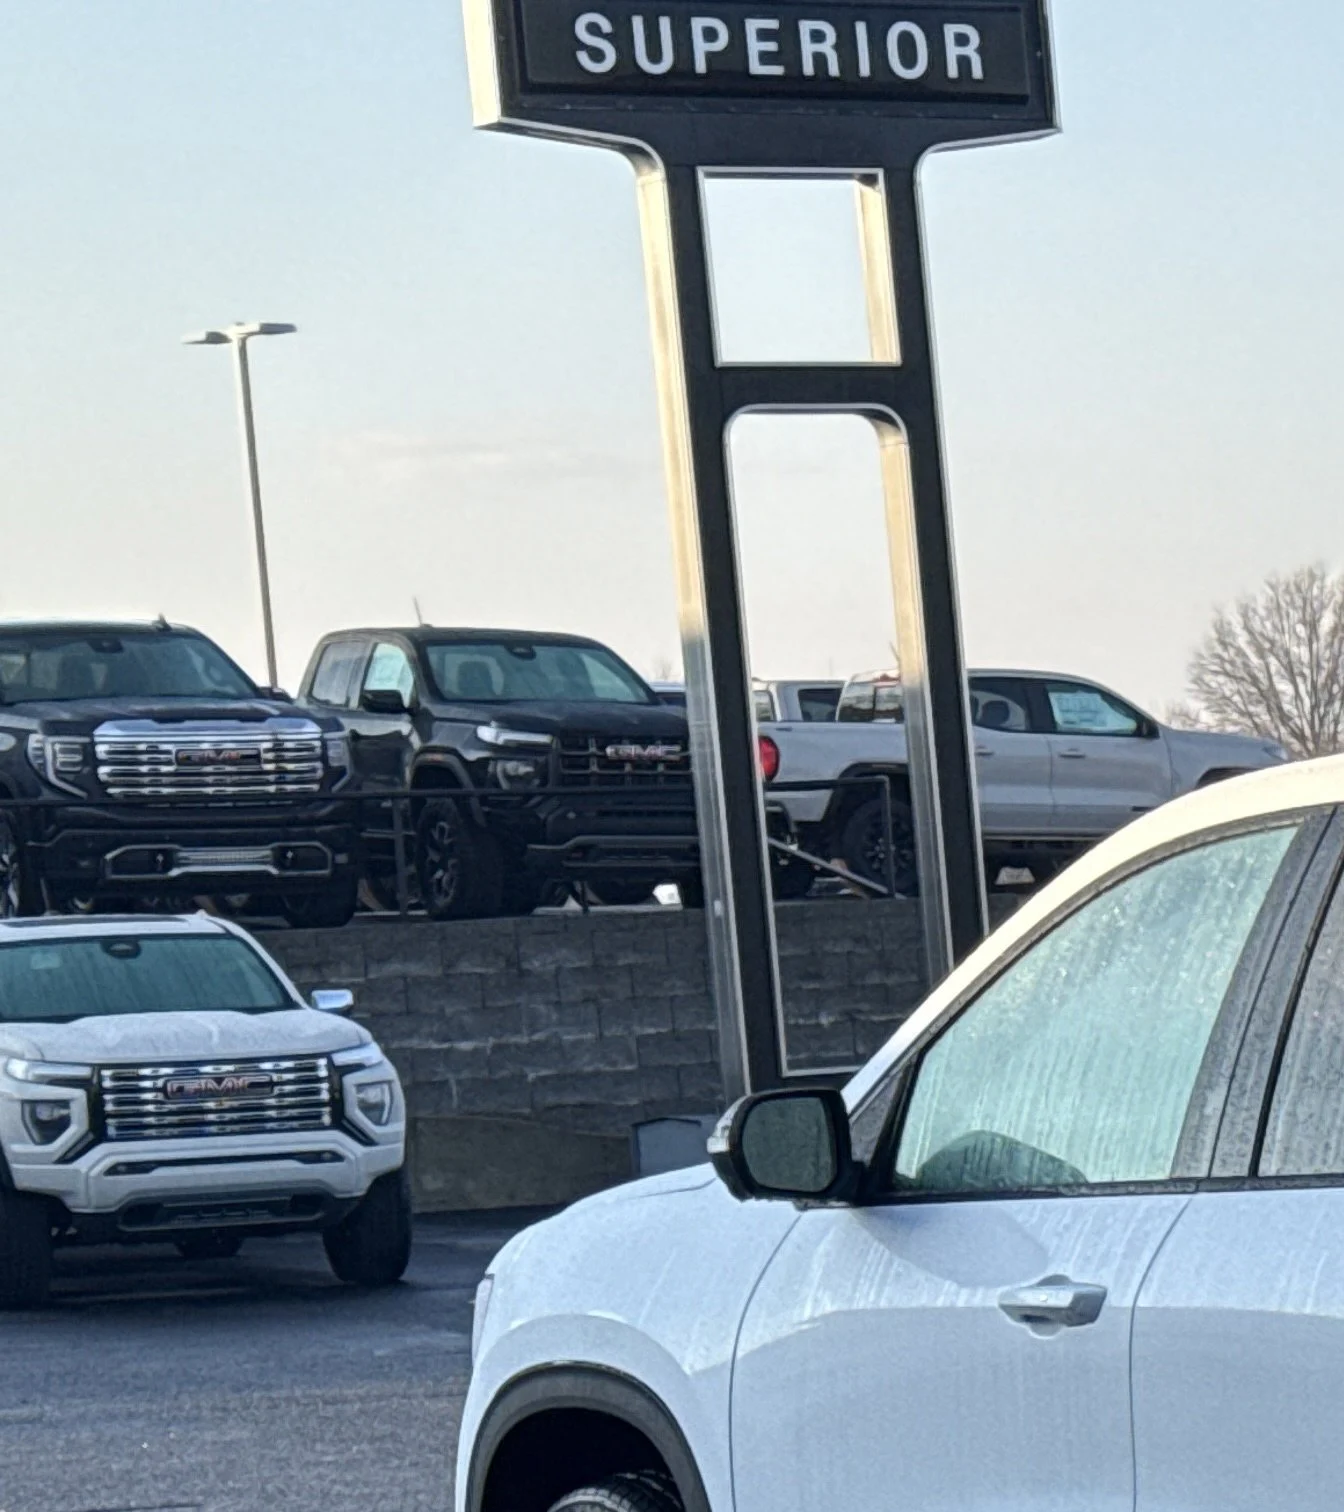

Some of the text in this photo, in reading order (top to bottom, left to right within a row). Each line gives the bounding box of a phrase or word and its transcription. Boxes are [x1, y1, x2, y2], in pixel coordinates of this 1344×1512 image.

[573, 12, 984, 80] SUPERIOR
[605, 744, 682, 762] GMC
[167, 1075, 272, 1101] GMC
